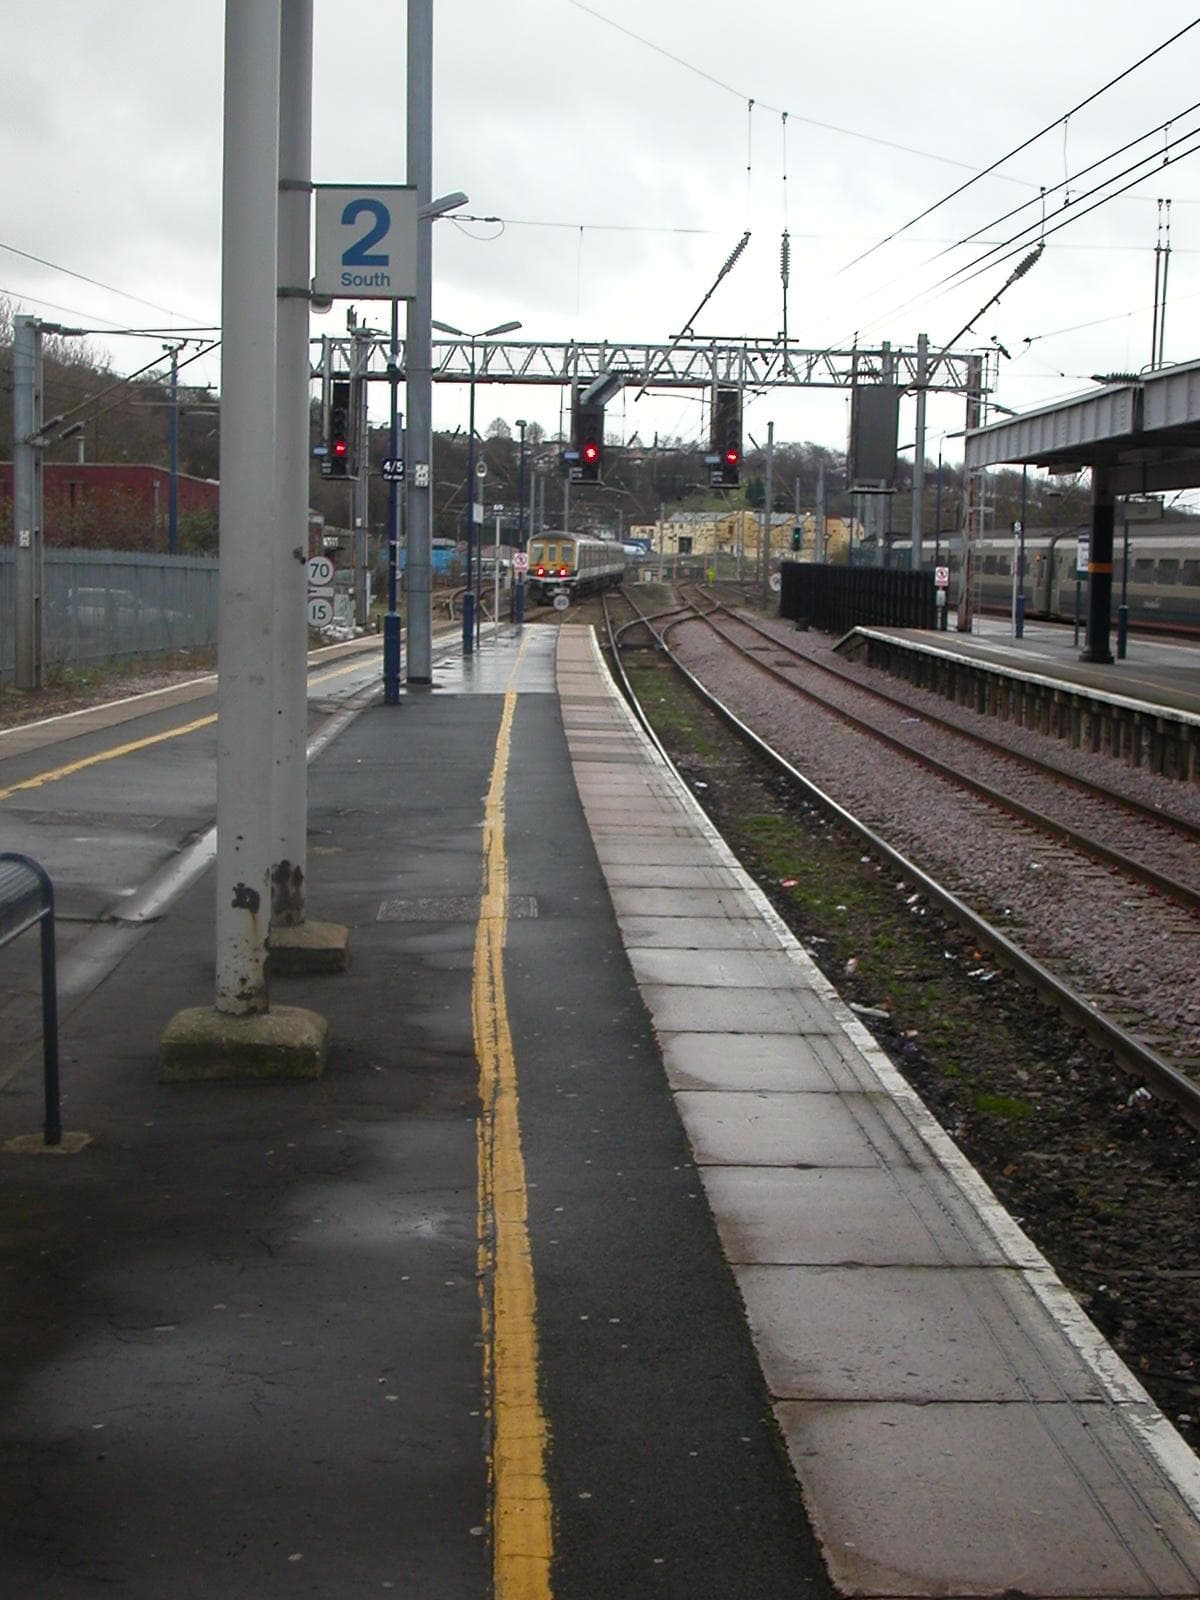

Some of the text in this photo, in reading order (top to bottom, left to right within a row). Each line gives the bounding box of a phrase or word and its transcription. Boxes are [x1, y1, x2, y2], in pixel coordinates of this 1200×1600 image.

[341, 198, 391, 266] 2
[341, 272, 391, 286] South
[383, 461, 404, 473] 4/5
[310, 563, 329, 578] 70
[312, 605, 327, 620] 15
